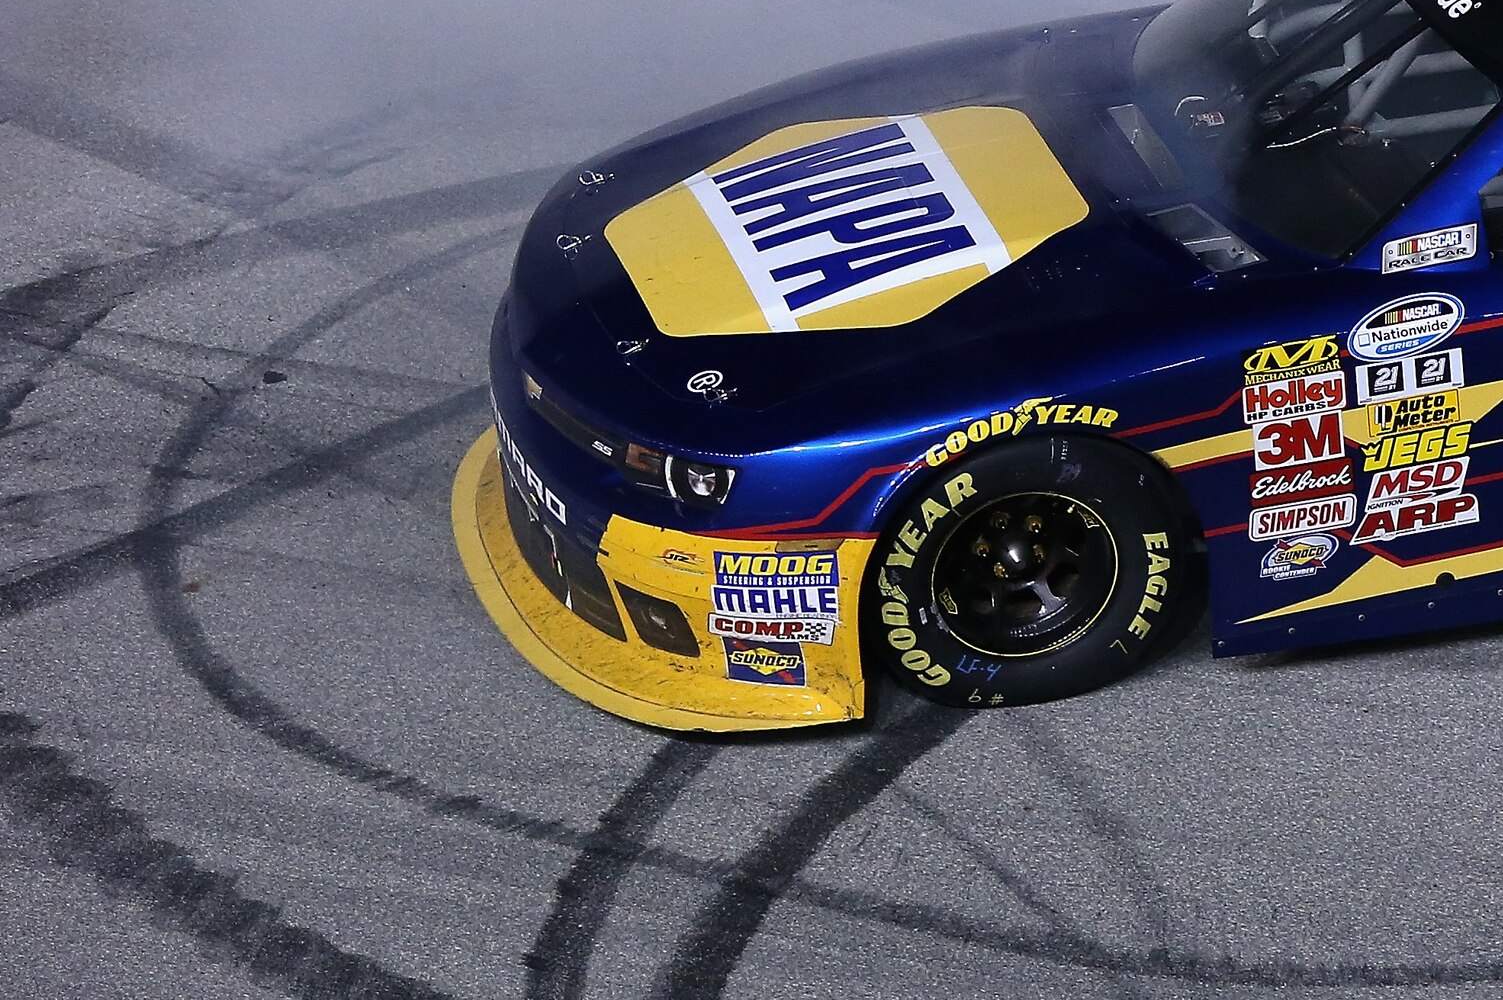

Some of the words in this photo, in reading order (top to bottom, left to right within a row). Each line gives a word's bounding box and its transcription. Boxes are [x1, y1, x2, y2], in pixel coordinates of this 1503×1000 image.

[710, 123, 977, 312] NAPA
[1417, 231, 1460, 251] NASCAR
[1389, 253, 1431, 268] RACE
[1434, 247, 1470, 259] CAR
[1403, 303, 1440, 321] NASCAR
[1372, 320, 1448, 343] Nationwide
[1380, 339, 1419, 352] SERIES
[1245, 369, 1306, 386] MECHANIX
[1306, 359, 1341, 375] WEAR
[1374, 366, 1399, 387] 21
[1422, 357, 1446, 379] 21
[1245, 378, 1342, 413] Holley
[1396, 395, 1445, 414] Auto
[1247, 412, 1268, 421] HP
[1272, 401, 1326, 417] CARBS
[1394, 407, 1456, 429] Meter
[592, 440, 613, 457] SS
[1258, 414, 1342, 465] 3M
[1364, 423, 1472, 472] JEGS
[1252, 465, 1351, 499] Edelbrock
[1372, 461, 1463, 499] MSD
[1258, 501, 1346, 534] SIMPSON
[1356, 496, 1475, 539] ARP
[718, 554, 834, 576] MOOG
[1276, 547, 1324, 562] SUNOCO
[723, 575, 764, 586] STEERING
[776, 576, 832, 586] SUSPENSION
[1127, 532, 1170, 640] EAGLE
[713, 587, 837, 614] MAHLE
[715, 618, 804, 637] COMP
[776, 633, 820, 642] CAMS
[733, 652, 798, 667] SUNOCO
